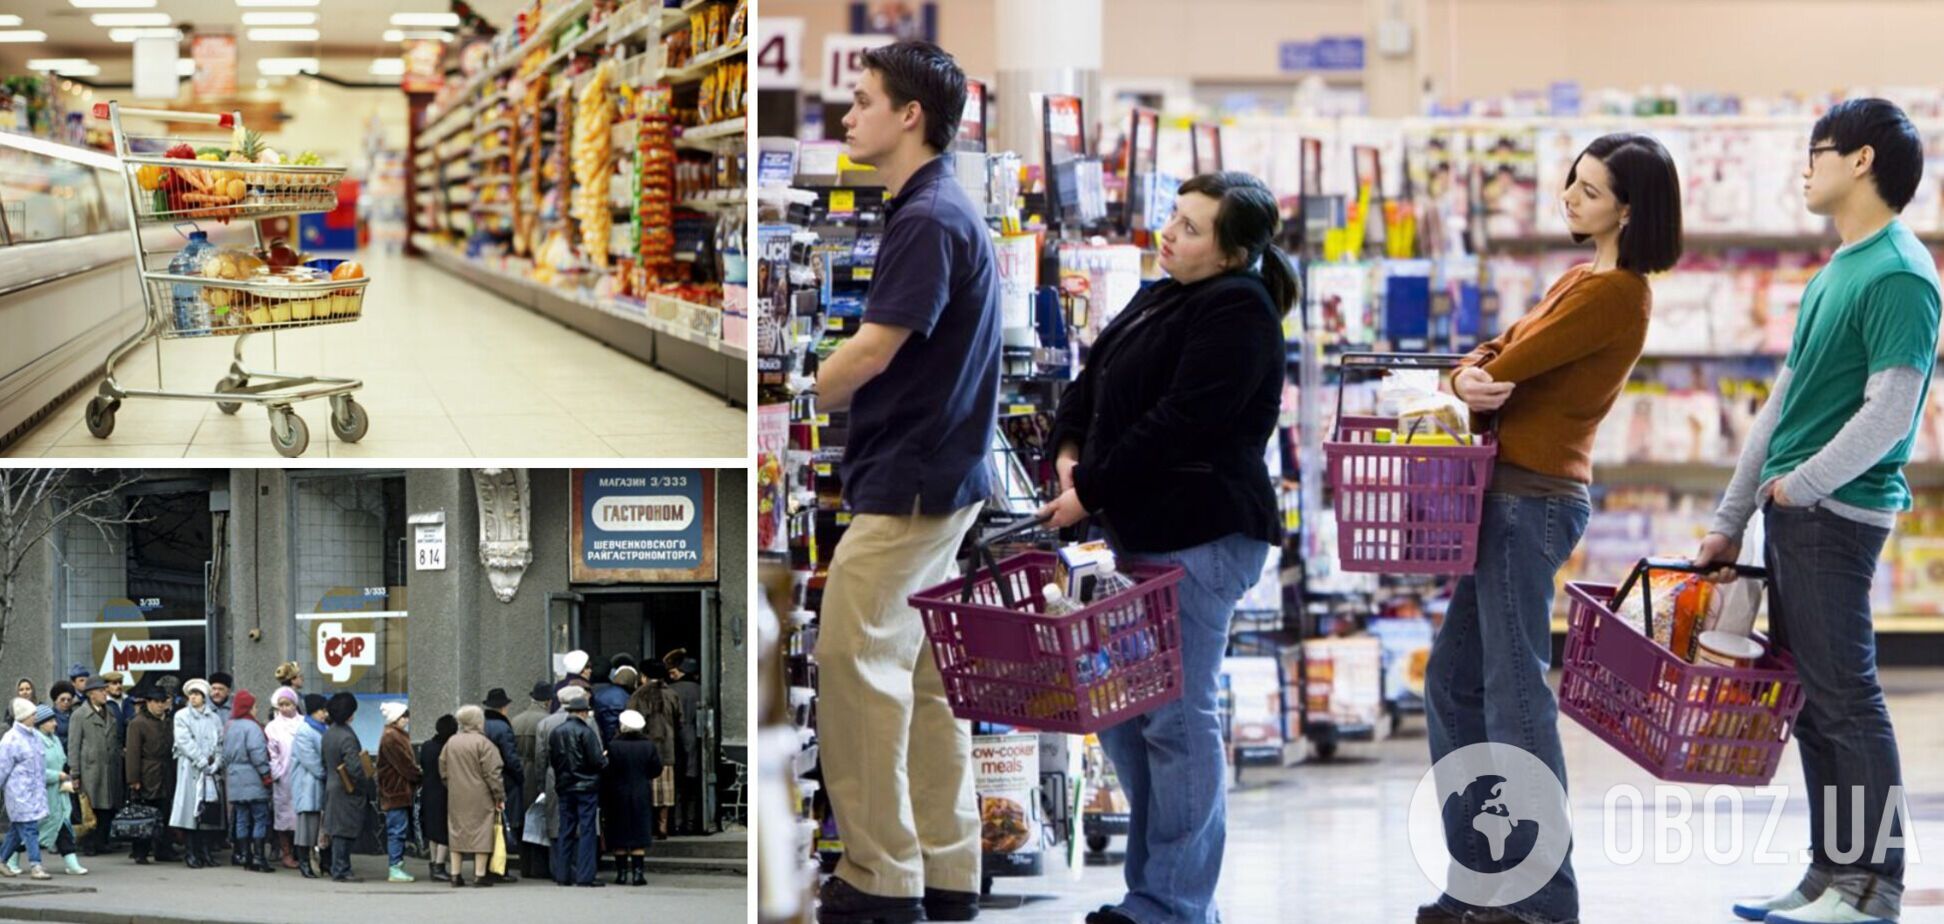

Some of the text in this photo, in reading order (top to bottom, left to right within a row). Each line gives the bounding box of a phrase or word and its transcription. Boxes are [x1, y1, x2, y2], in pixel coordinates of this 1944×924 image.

[599, 476, 687, 487] МАГАЗИН 3/333
[603, 505, 684, 522] ГАСТРОНОМ
[593, 539, 687, 550] ШЕВЧЕНКОВСКОГО
[419, 548, 440, 565] 8 14
[587, 548, 697, 561] РАЙГАСТРОНОМТОРГА
[363, 587, 386, 596] 3/333
[139, 598, 160, 606] 3/333
[981, 759, 1023, 774] meals
